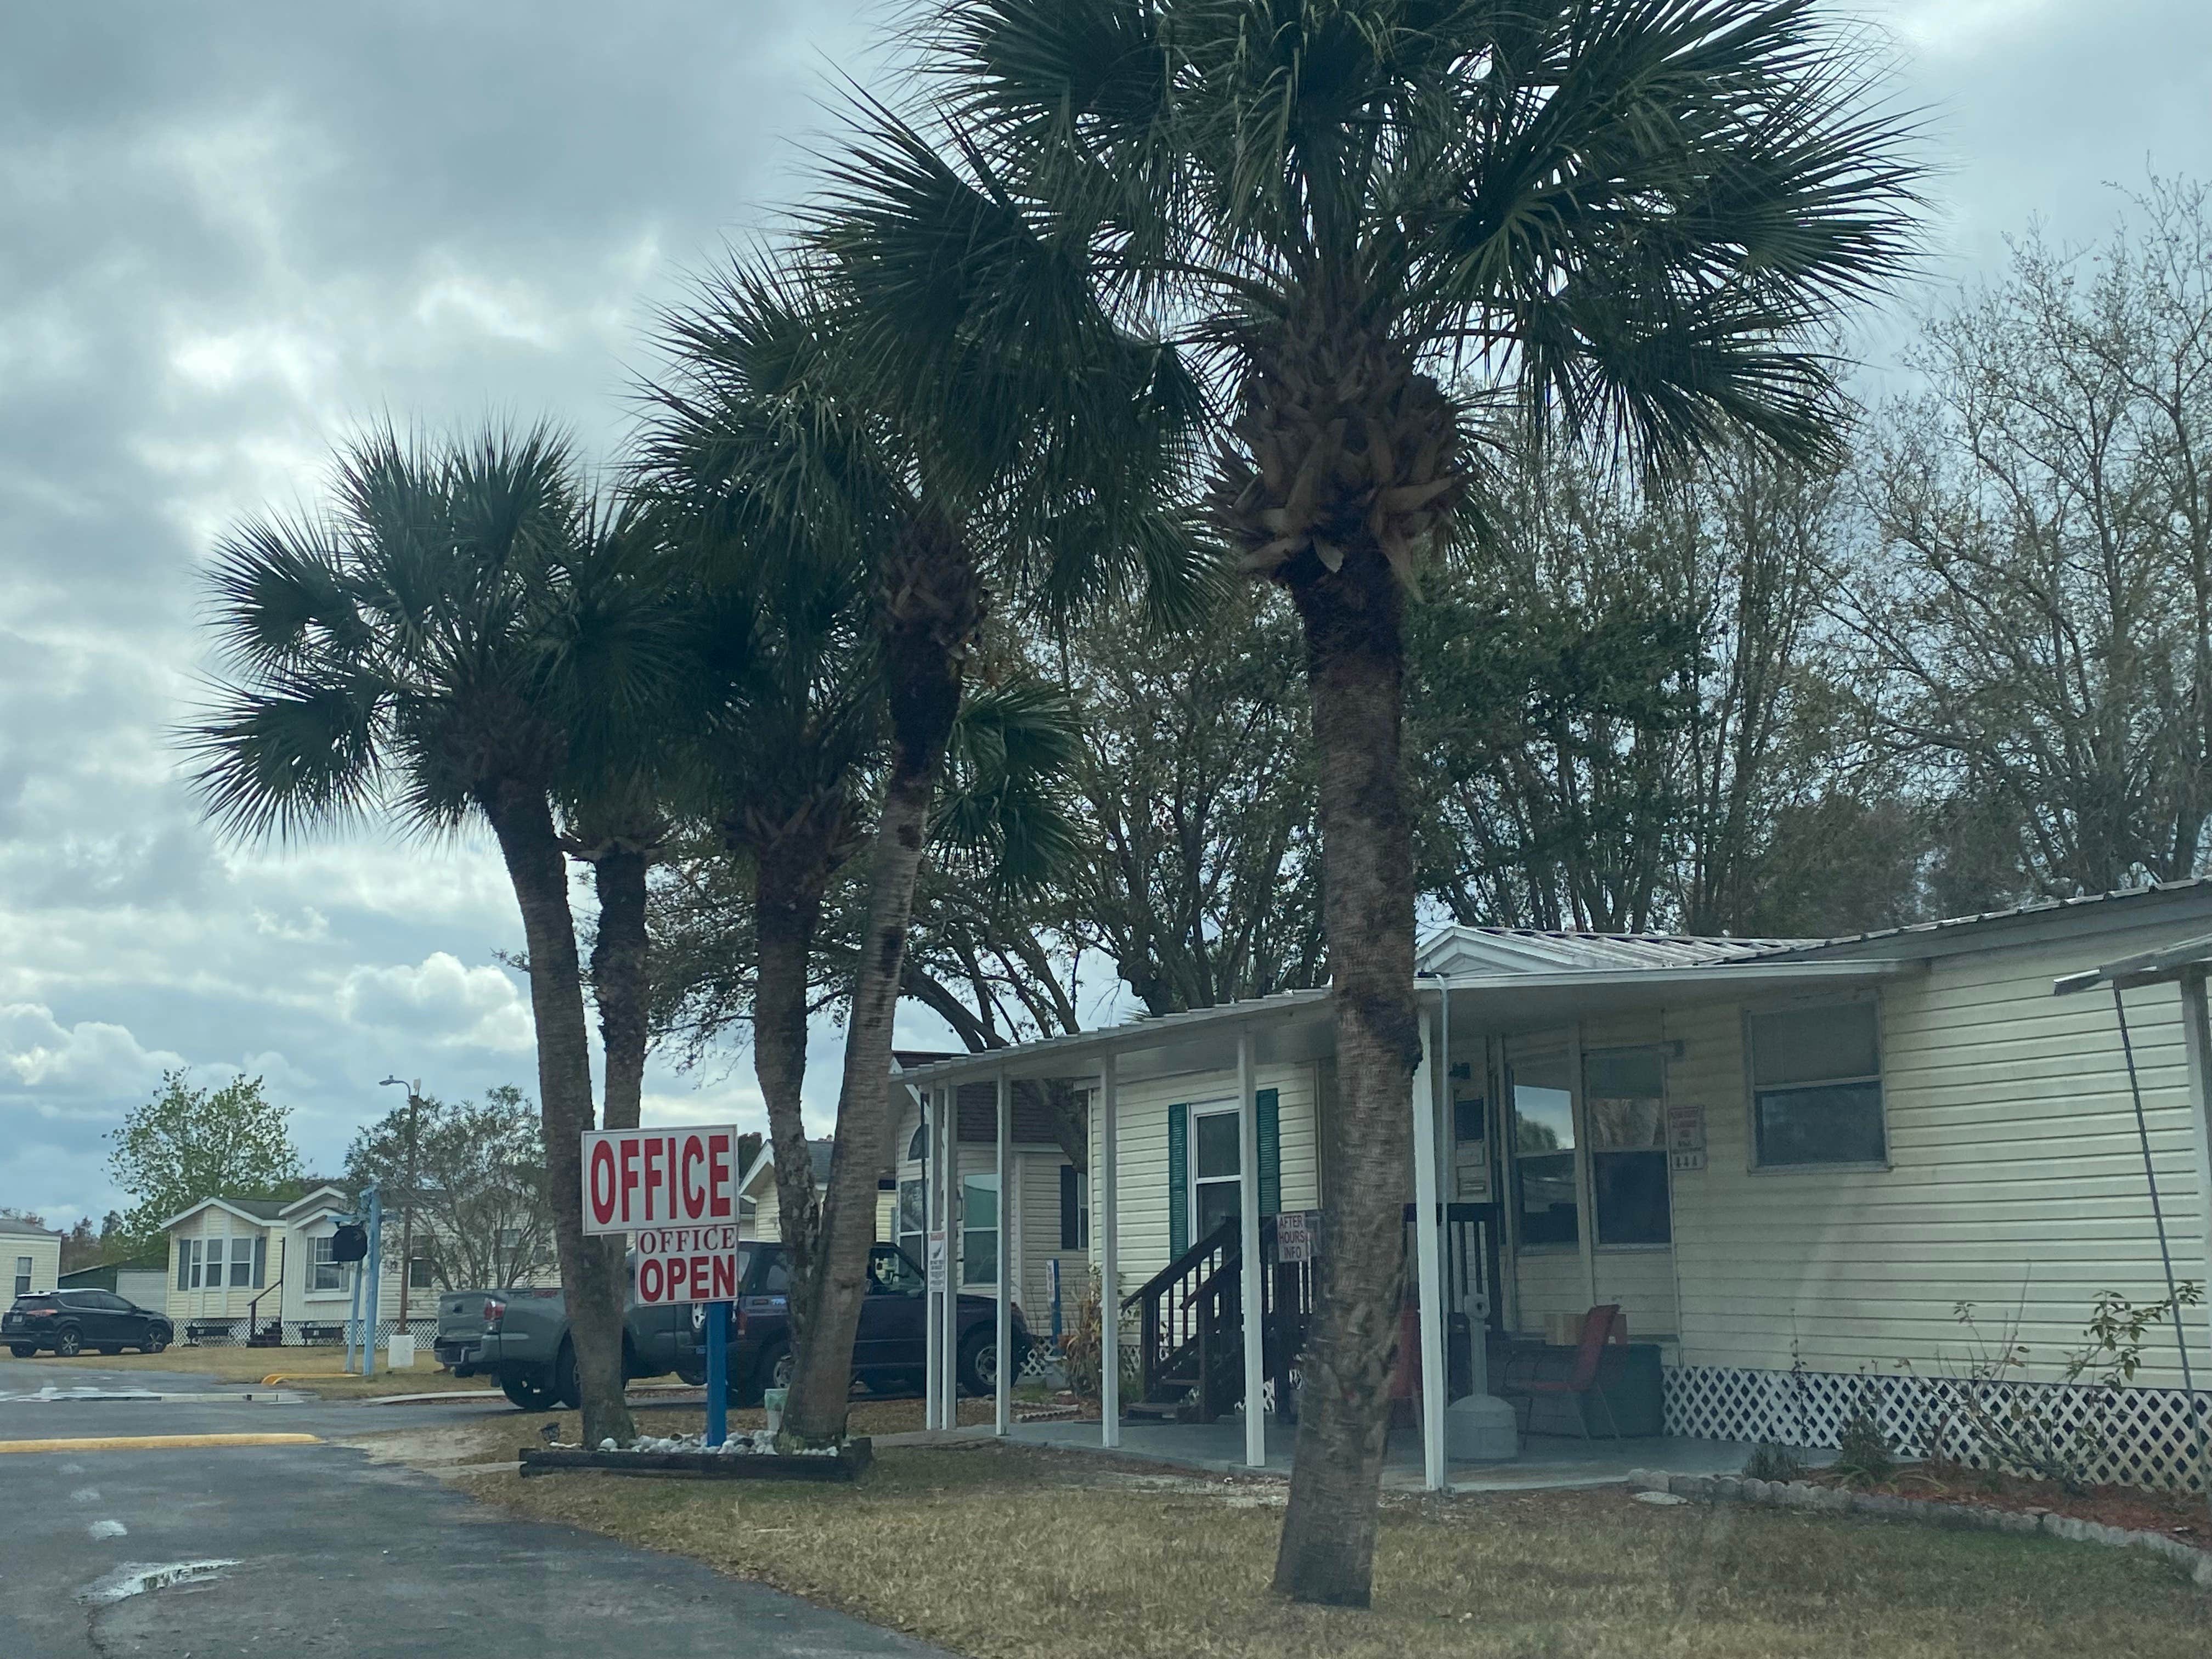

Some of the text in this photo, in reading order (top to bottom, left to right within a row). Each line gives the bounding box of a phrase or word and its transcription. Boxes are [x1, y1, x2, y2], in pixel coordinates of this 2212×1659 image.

[591, 1135, 731, 1224] OFFICE
[1279, 1215, 1303, 1229] AFTER
[640, 1228, 735, 1254] OFFICE
[1279, 1230, 1305, 1244] HOURS
[1284, 1246, 1301, 1259] INFO
[640, 1255, 735, 1302] OPEN
